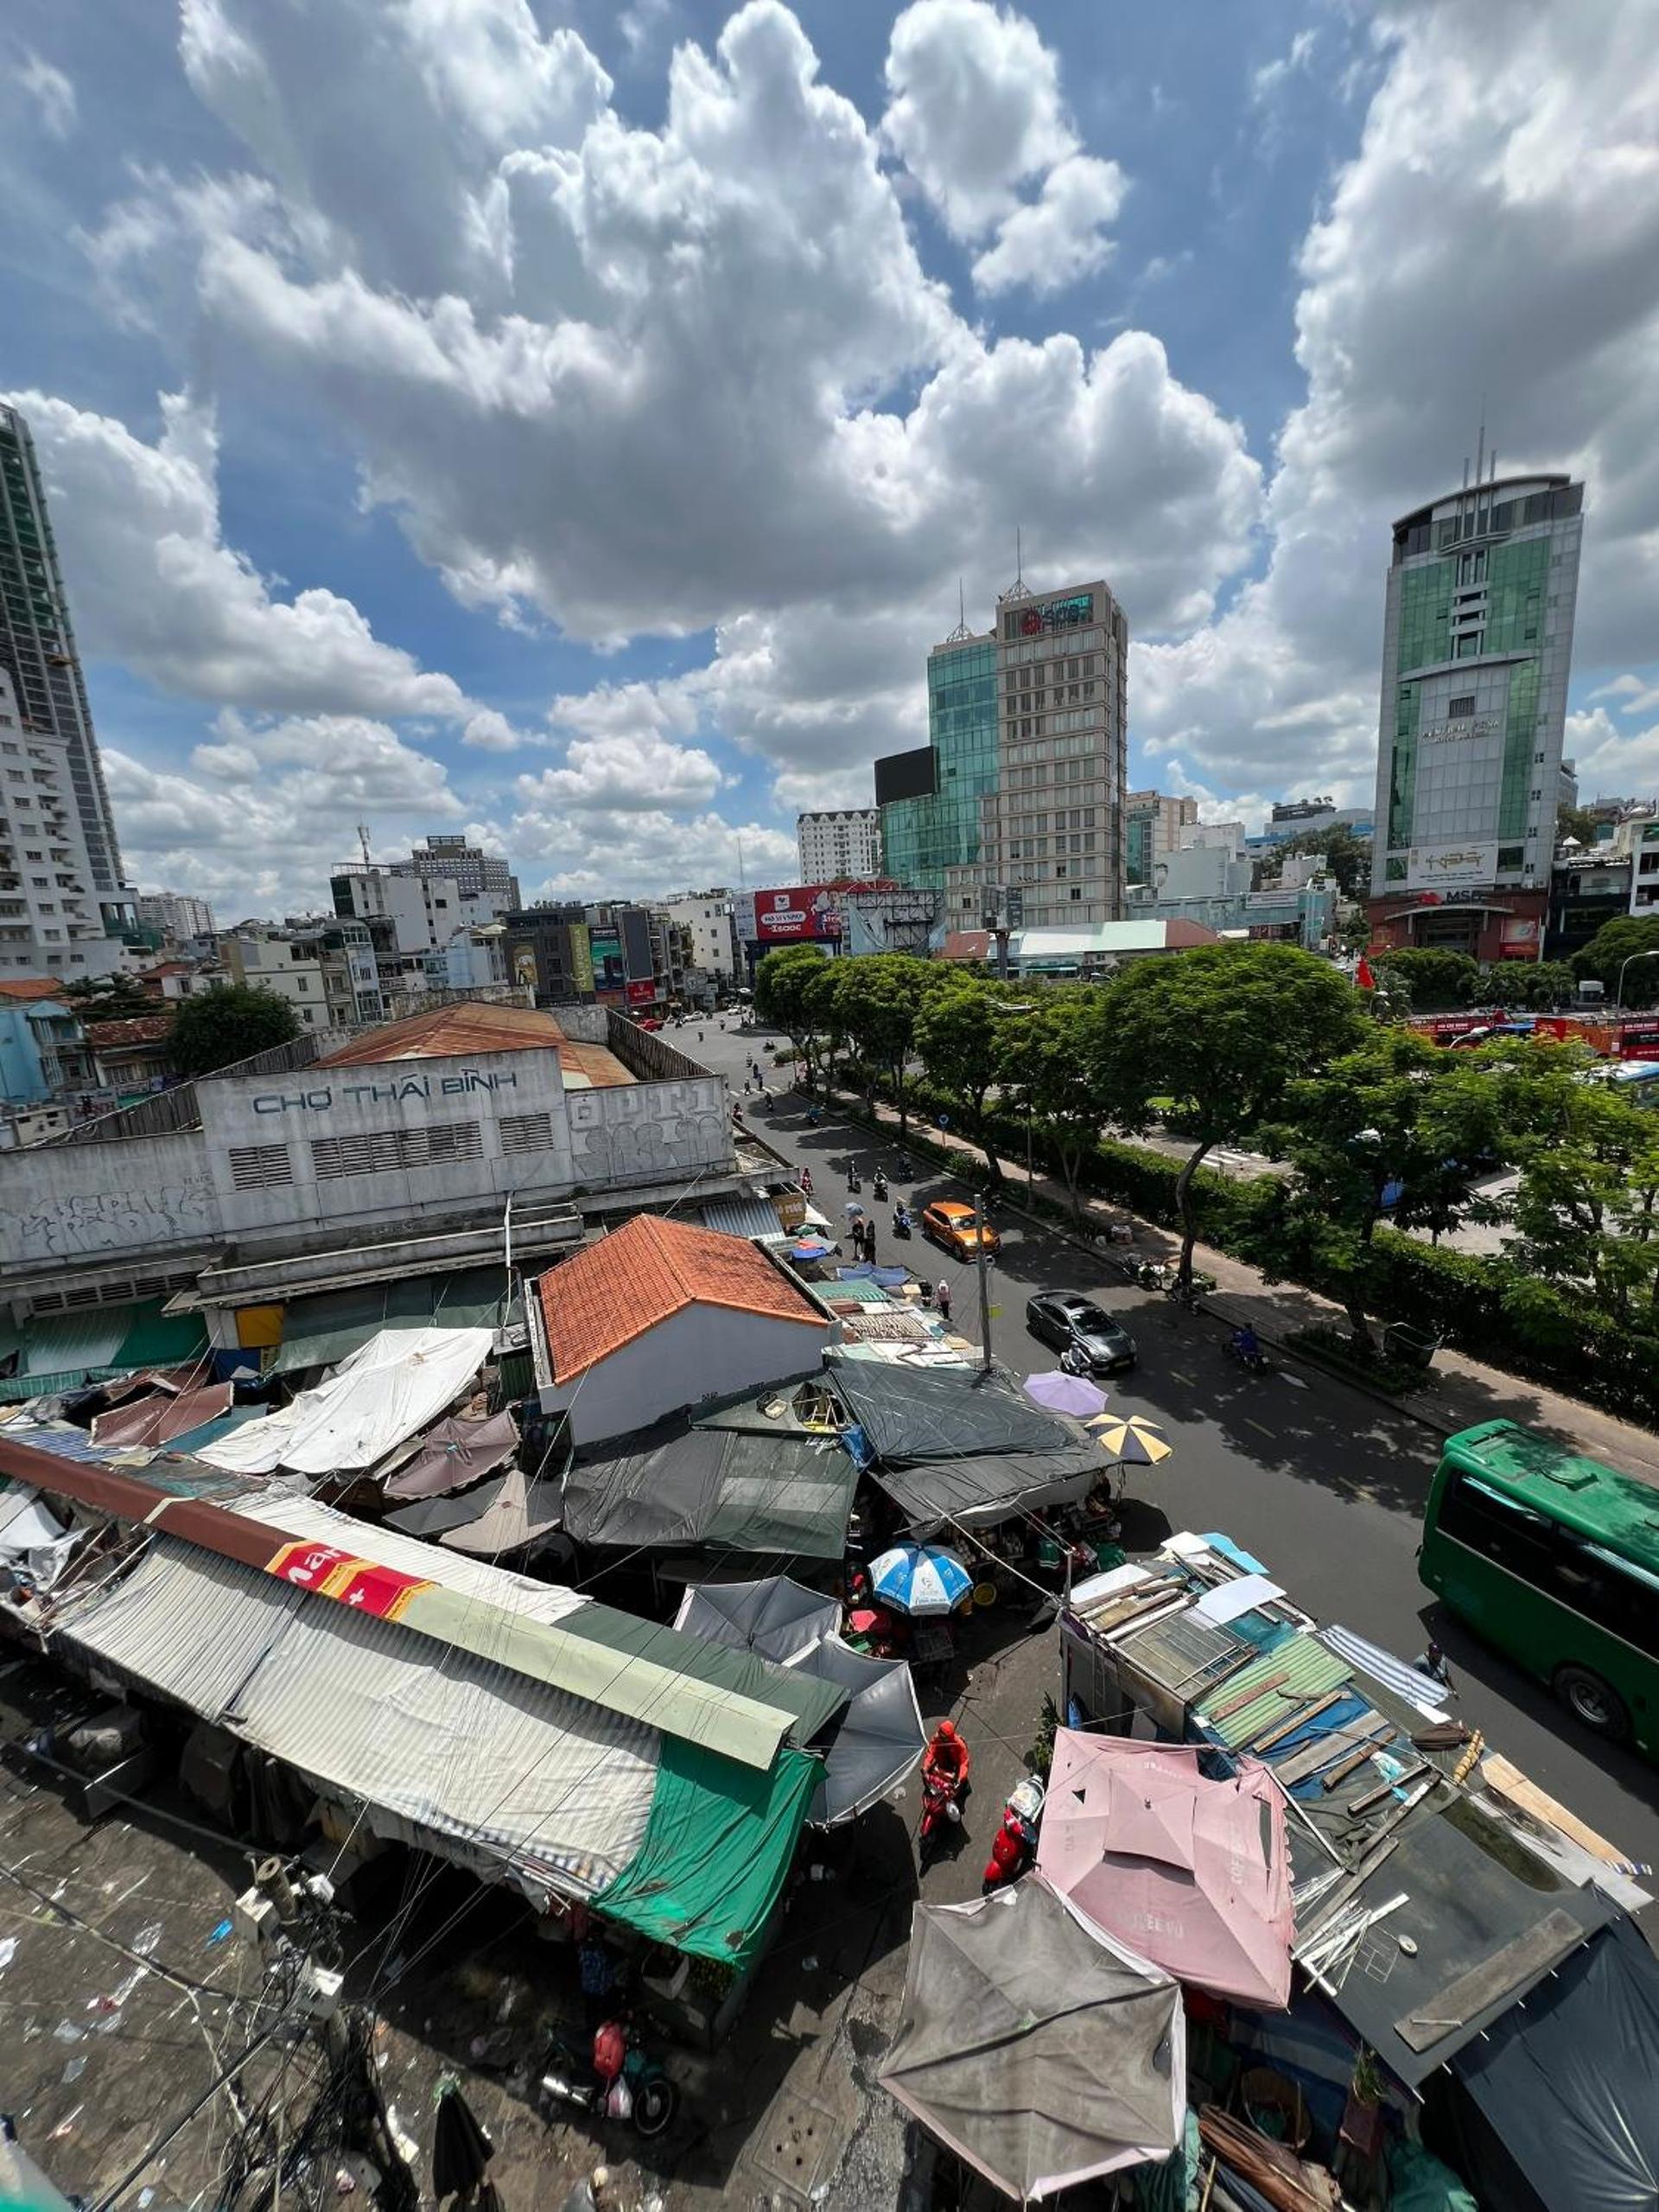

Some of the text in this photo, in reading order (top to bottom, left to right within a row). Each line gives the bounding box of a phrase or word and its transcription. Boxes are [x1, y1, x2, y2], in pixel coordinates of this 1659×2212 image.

[253, 1067, 518, 1115] CHỢ THÁI BÌNH
